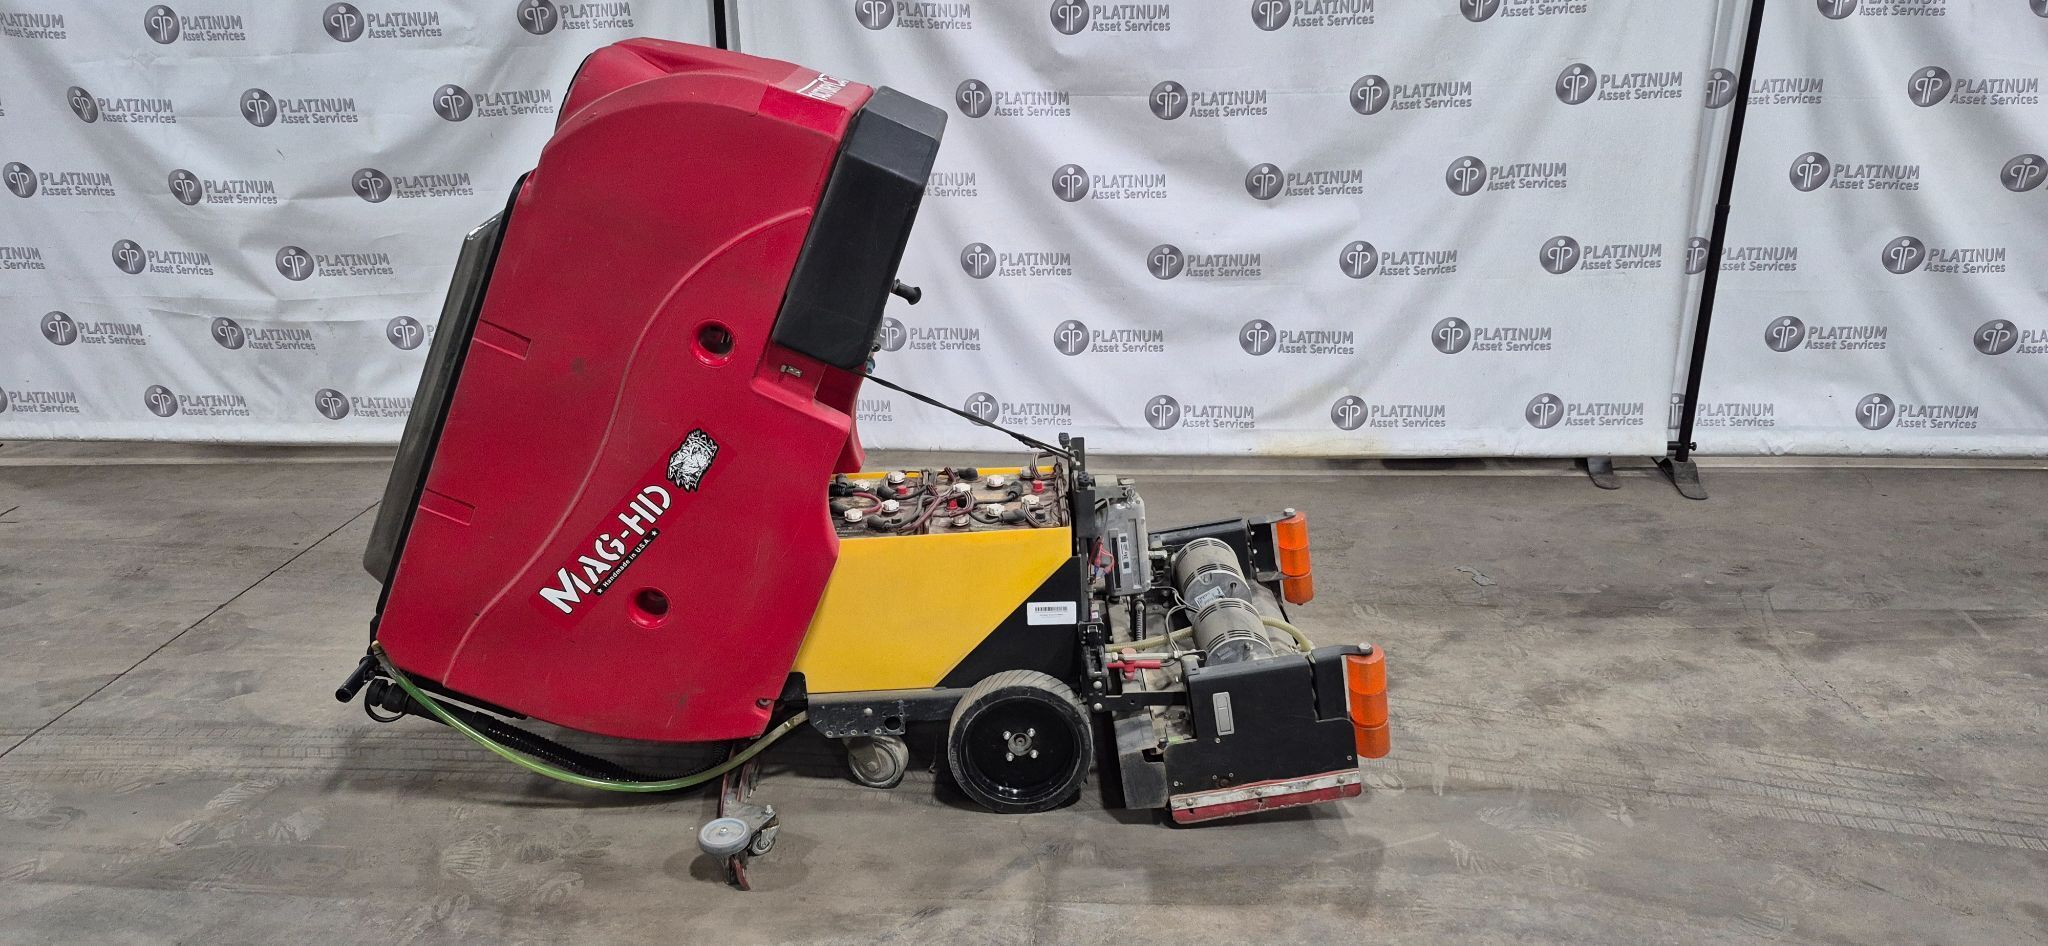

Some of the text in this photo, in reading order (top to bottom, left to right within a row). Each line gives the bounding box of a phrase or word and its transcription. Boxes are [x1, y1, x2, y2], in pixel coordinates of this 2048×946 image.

[560, 2, 630, 19] PLATINUM
[897, 2, 970, 18] PLATINUM
[1092, 4, 1169, 21] PLATINUM
[1294, 0, 1373, 15] PLATINUM
[1501, 4, 1587, 17] Asset Services
[1860, 5, 1946, 16] Asset Services
[181, 15, 242, 31] PLATINUM
[367, 12, 439, 28] PLATINUM
[562, 18, 634, 30] Asset Services
[897, 17, 971, 29] Asset Services
[1091, 20, 1170, 31] Asset Services
[1293, 14, 1374, 27] Asset Services
[23, 28, 66, 39] Services
[183, 30, 245, 41] Asset Services
[368, 27, 442, 38] Asset Services
[1600, 72, 1682, 89] PLATINUM
[1752, 78, 1823, 93] LATINUM
[1954, 77, 2038, 94] PLATINUM
[1393, 82, 1471, 99] PLATINUM
[1598, 88, 1682, 100] Asset Services
[475, 89, 551, 107] PLATINUM
[995, 91, 1069, 105] PLATINUM
[1191, 90, 1266, 106] PLATINUM
[1390, 97, 1472, 110] Asset Services
[1773, 93, 1822, 104] Services
[1950, 93, 2038, 105] Asset Services
[99, 98, 173, 113] PLATINUM
[278, 98, 355, 114] PLATINUM
[478, 105, 553, 117] Asset Services
[994, 106, 1070, 116] Asset Services
[1190, 105, 1267, 117] Asset Services
[102, 112, 176, 123] Asset Services
[281, 113, 358, 124] Asset Services
[1490, 163, 1566, 180] PLATINUM
[1833, 164, 1919, 179] PLATINUM
[40, 172, 111, 185] PLATINUM
[393, 173, 470, 189] PLATINUM
[929, 172, 975, 186] TINUM
[1093, 174, 1165, 188] PLATINUM
[1287, 170, 1362, 186] PLATINUM
[42, 185, 115, 196] Asset Services
[204, 180, 274, 193] PLATINUM
[1285, 184, 1363, 196] Asset Services
[1487, 178, 1566, 191] Asset Services
[1829, 179, 1919, 190] Asset Services
[395, 187, 473, 198] Asset Services
[934, 187, 977, 197] Services
[1092, 189, 1166, 199] Asset Services
[207, 193, 277, 204] Asset Services
[0, 247, 41, 260] TINUM
[147, 250, 210, 265] PLATINUM
[1583, 244, 1661, 259] PLATINUM
[1928, 247, 2005, 262] PLATINUM
[3, 260, 45, 269] Services
[316, 253, 389, 267] PLATINUM
[1000, 253, 1070, 267] PLATINUM
[1187, 254, 1260, 268] PLATINUM
[1381, 250, 1457, 267] PLATINUM
[1580, 258, 1661, 270] Asset Services
[150, 263, 213, 275] Asset Services
[319, 266, 393, 277] Asset Services
[999, 266, 1071, 276] Asset Services
[1379, 265, 1456, 275] Asset Services
[1749, 260, 1796, 271] Services
[1924, 262, 2005, 273] Asset Services
[1186, 267, 1261, 277] Asset Services
[78, 322, 142, 336] PLATINUM
[245, 328, 312, 341] PLATINUM
[910, 328, 979, 340] PLATINUM
[1474, 328, 1551, 342] PLATINUM
[1807, 326, 1887, 339] PLATINUM
[81, 335, 146, 345] Asset Services
[1093, 330, 1163, 342] PLATINUM
[1280, 330, 1353, 344] PLATINUM
[248, 340, 315, 350] Asset Services
[910, 340, 980, 350] Asset Services
[1091, 343, 1163, 352] Asset Services
[1278, 344, 1354, 354] Asset Services
[1472, 341, 1551, 351] Asset Services
[1805, 339, 1885, 350] Asset Services
[2016, 344, 2048, 353] Asset
[9, 391, 76, 403] PLATINUM
[178, 395, 246, 408] PLATINUM
[12, 404, 79, 413] Asset Services
[181, 407, 249, 416] Asset Services
[354, 409, 379, 417] Asset
[1002, 403, 1070, 416] PLATINUM
[1184, 405, 1254, 419] PLATINUM
[1371, 403, 1445, 418] PLATINUM
[1567, 403, 1643, 417] PLATINUM
[1697, 403, 1773, 416] PLATINUM
[1898, 404, 1978, 418] PLATINUM
[858, 413, 892, 421] ervices
[1001, 416, 1071, 425] Asset Services
[1369, 418, 1445, 427] Asset Services
[1565, 416, 1643, 426] Asset Services
[1696, 417, 1775, 426] Asset Services
[1182, 419, 1254, 428] Asset Services
[1896, 418, 1976, 429] Asset Services
[539, 485, 671, 614] MAG-HD
[602, 559, 631, 588] Handmade
